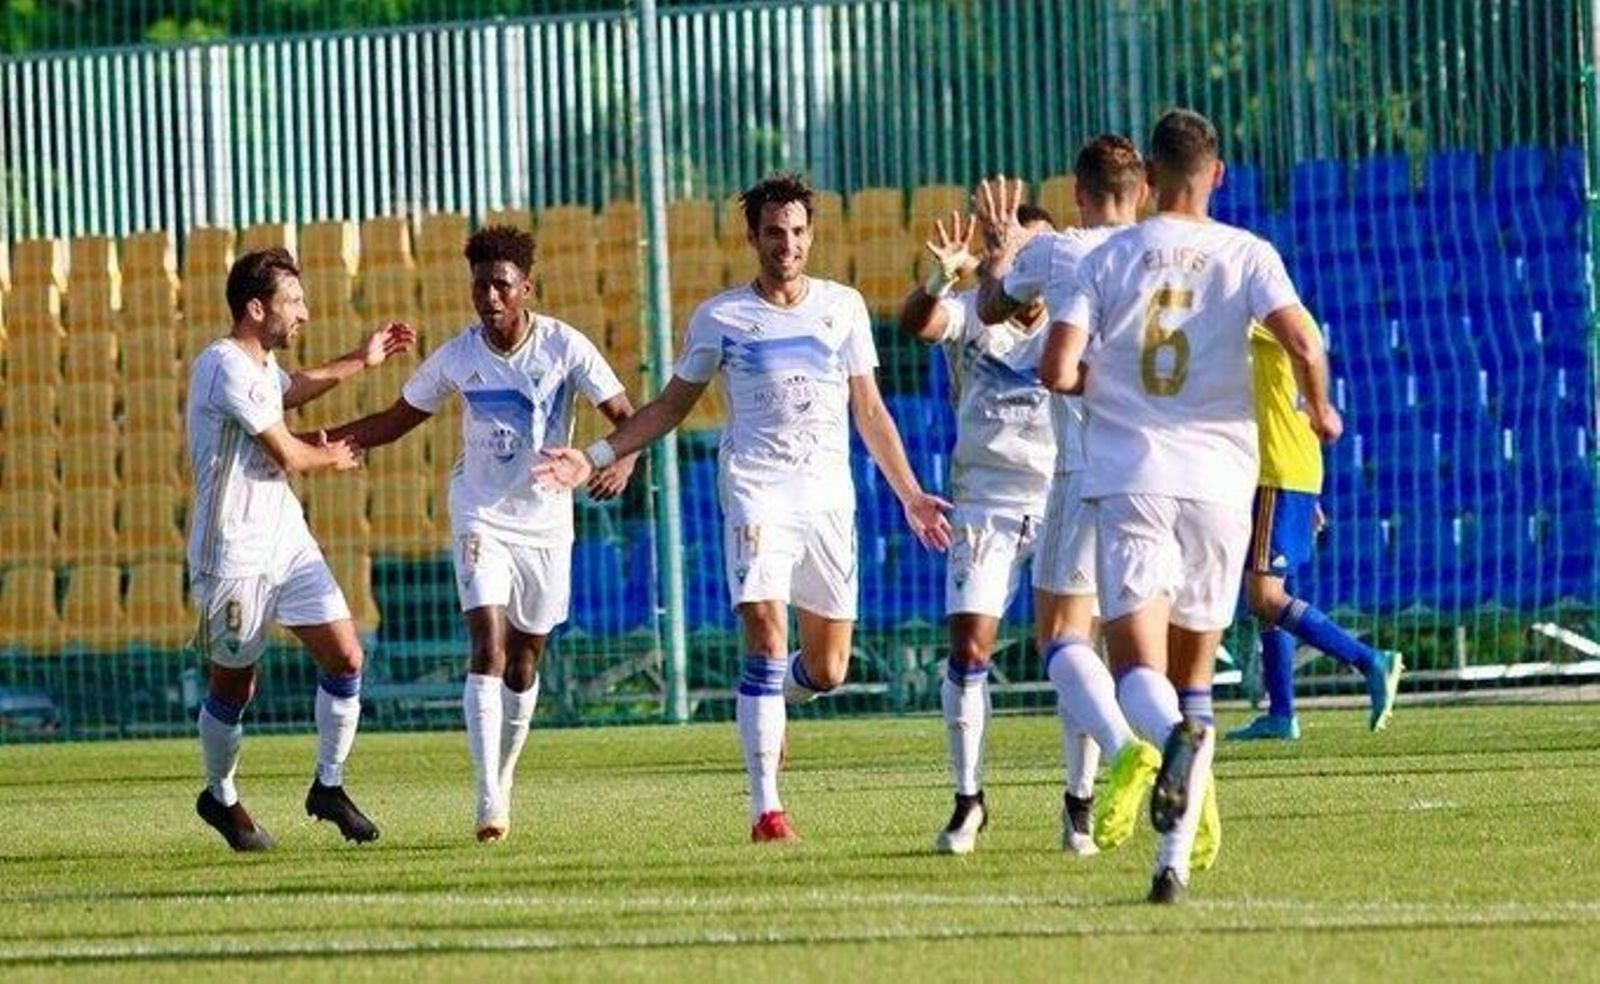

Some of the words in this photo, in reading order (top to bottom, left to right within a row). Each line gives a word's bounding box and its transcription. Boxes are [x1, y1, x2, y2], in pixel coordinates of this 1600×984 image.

[1140, 281, 1194, 397] 6
[732, 524, 761, 560] 14
[225, 598, 243, 633] 8
